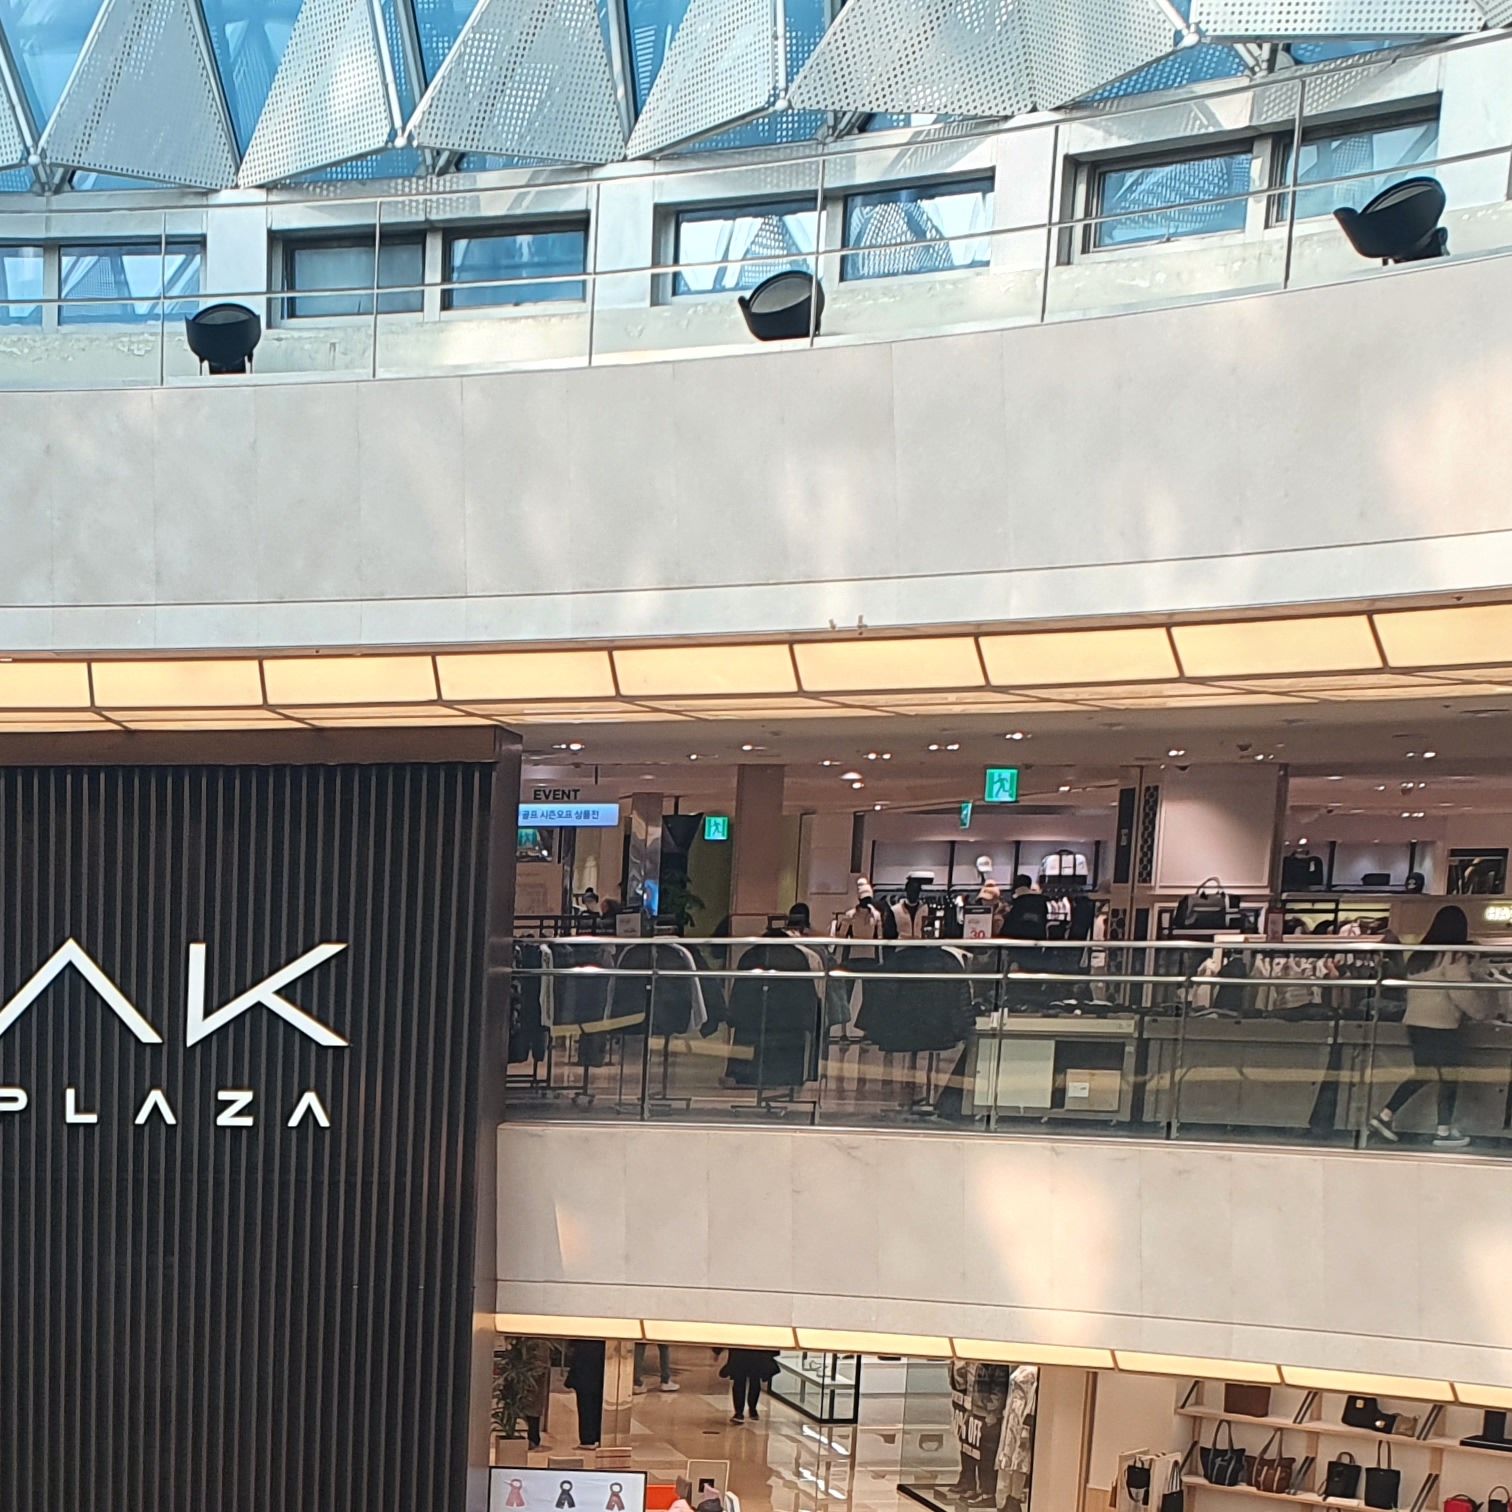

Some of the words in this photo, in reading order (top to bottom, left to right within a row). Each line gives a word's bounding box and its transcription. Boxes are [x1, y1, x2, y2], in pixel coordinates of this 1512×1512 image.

[533, 788, 581, 801] EVENT
[540, 809, 573, 820] 시즌오프
[574, 809, 600, 820] 상품전
